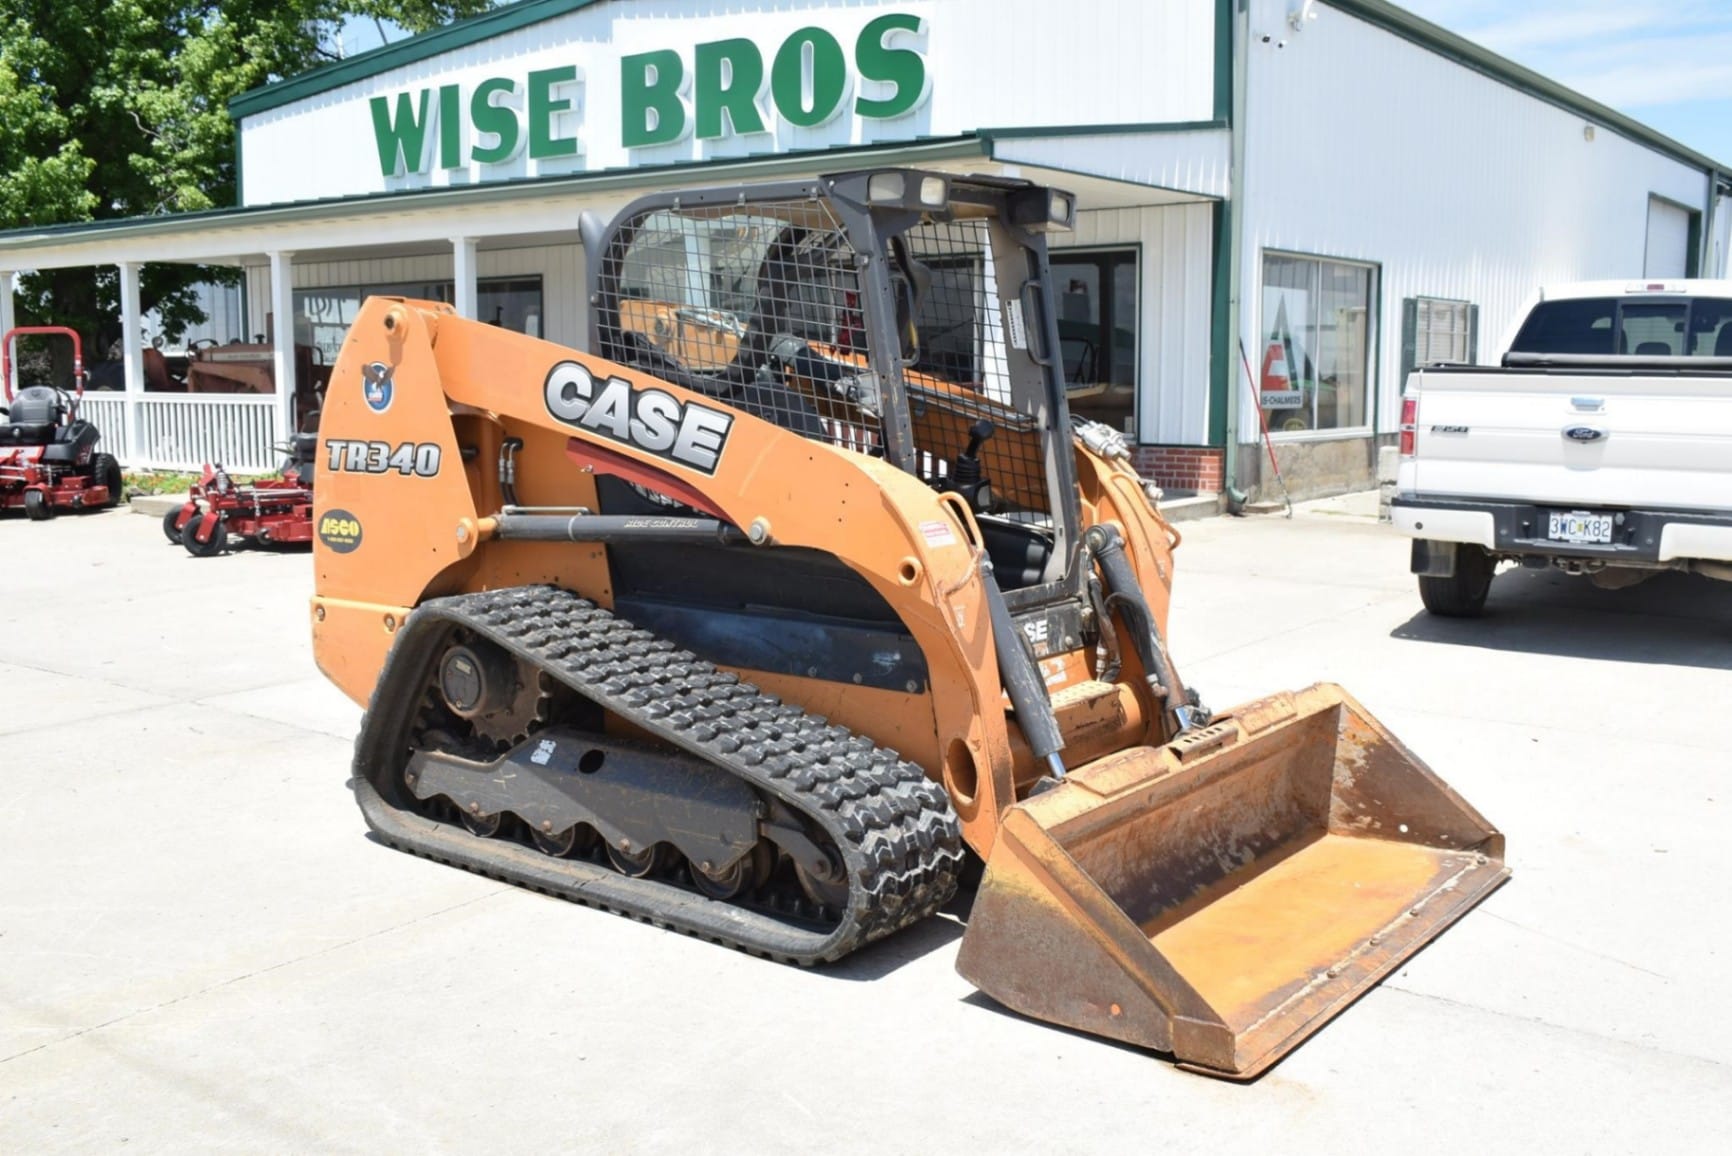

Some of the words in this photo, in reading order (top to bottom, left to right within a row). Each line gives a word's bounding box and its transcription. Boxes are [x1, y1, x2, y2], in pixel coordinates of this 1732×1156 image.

[369, 65, 579, 177] WISE
[621, 13, 927, 148] BROS
[545, 361, 734, 474] CASE
[1262, 395, 1301, 405] S-CHALMERS
[326, 439, 441, 477] TR340
[1024, 620, 1048, 642] SE
